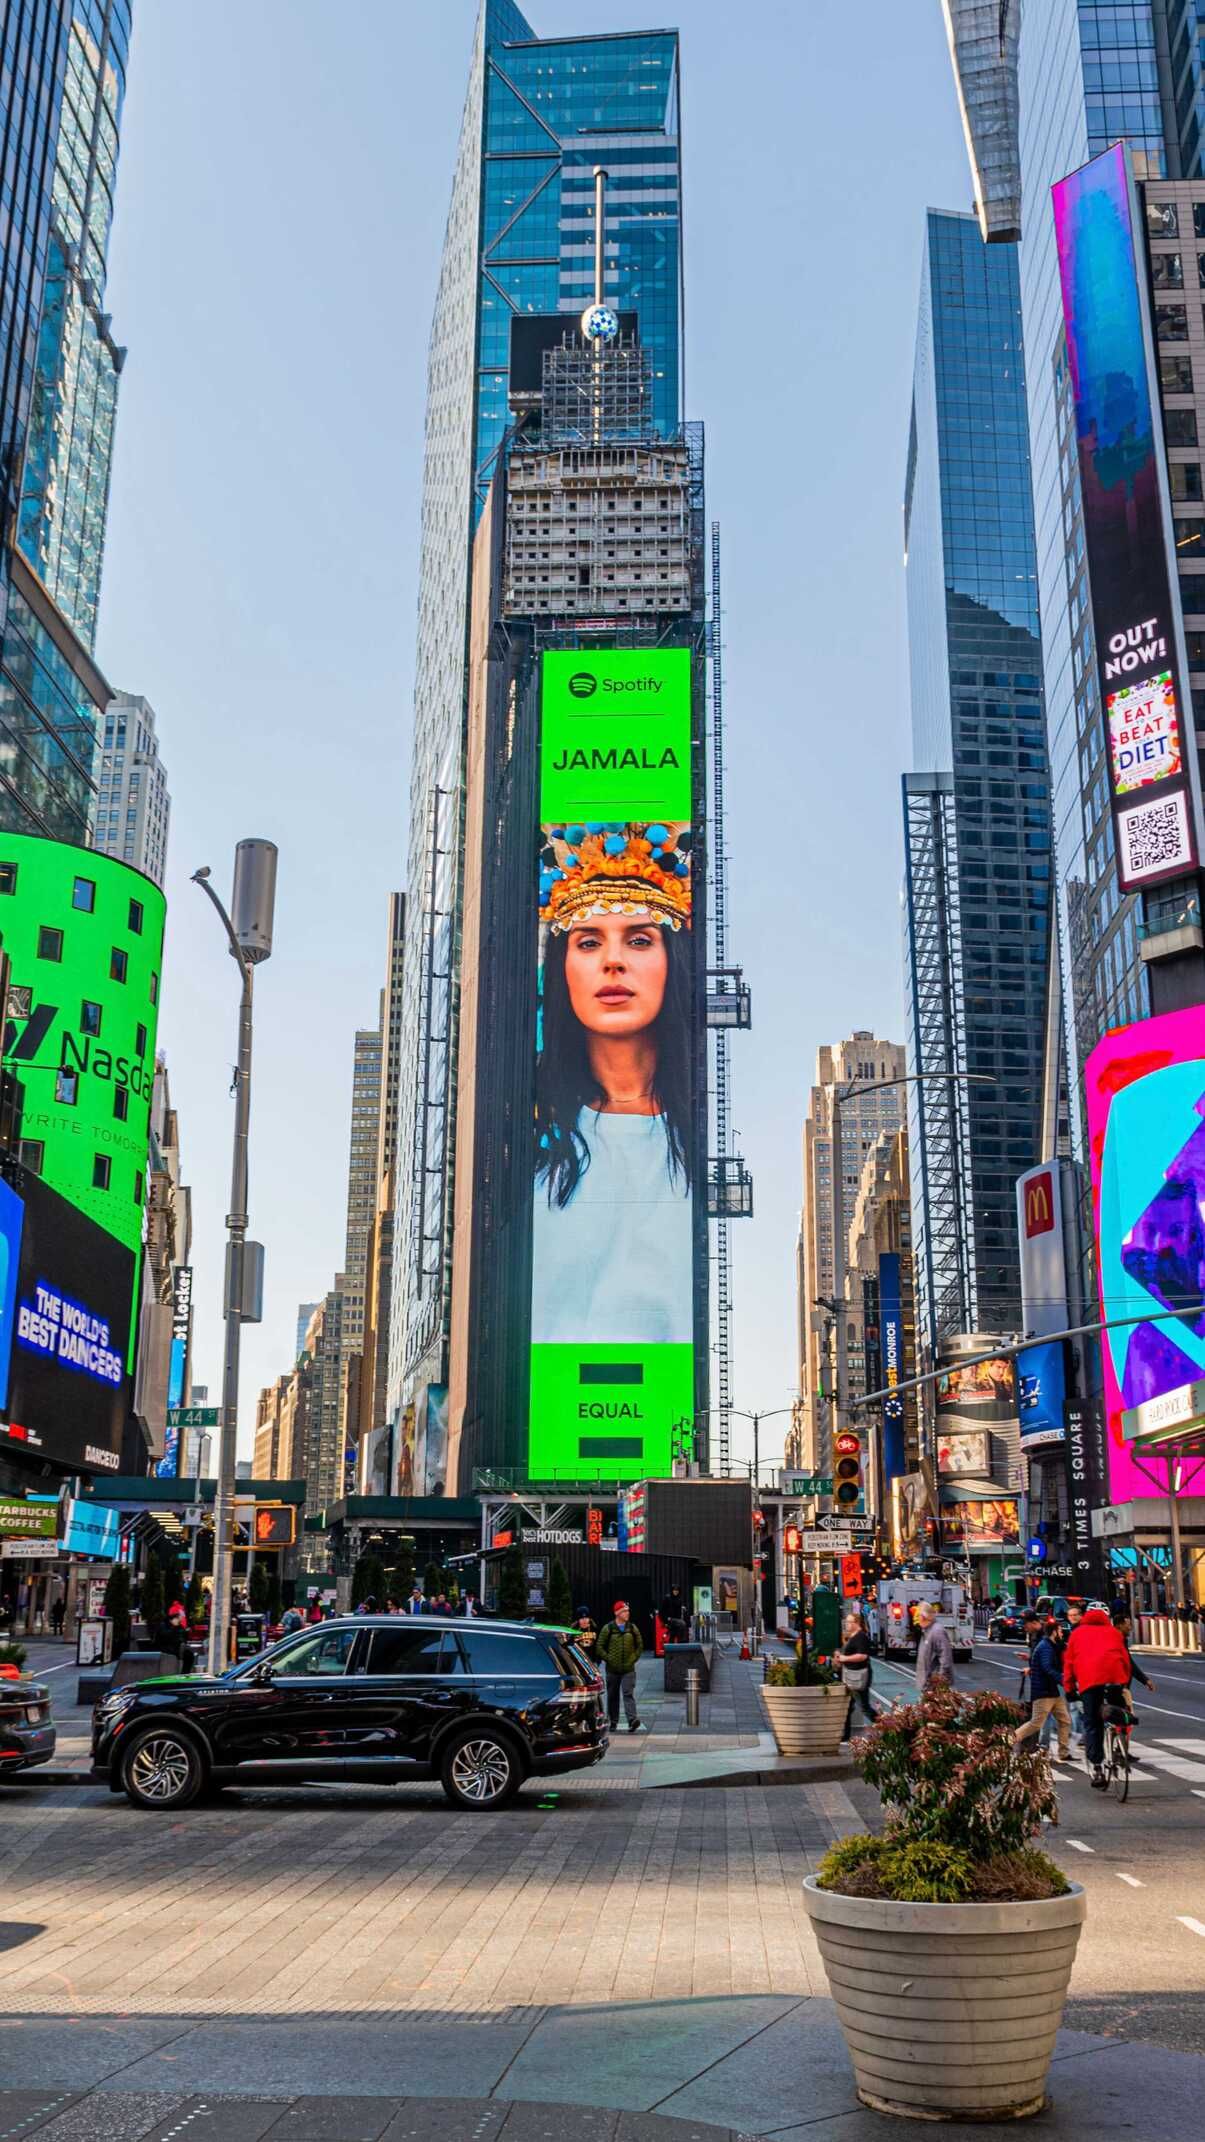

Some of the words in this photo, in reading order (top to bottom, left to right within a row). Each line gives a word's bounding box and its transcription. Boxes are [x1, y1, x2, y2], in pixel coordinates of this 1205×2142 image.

[1109, 618, 1157, 654] OUT
[1105, 638, 1167, 680] NOW!
[602, 677, 663, 693] Spotify
[1124, 700, 1155, 724] EAT
[1119, 716, 1164, 745] BEAT
[553, 747, 680, 770] JAMALA
[1119, 735, 1168, 770] DIET
[173, 1270, 192, 1321] Locker
[36, 1287, 61, 1322] THE
[61, 1302, 109, 1348] WORLD'S
[18, 1306, 59, 1352] BEST
[58, 1326, 122, 1383] DANCERS
[169, 1411, 180, 1425] W
[185, 1410, 202, 1425] 44
[578, 1403, 644, 1418] EQUAL
[1069, 1412, 1085, 1480] SQUARE
[794, 1480, 804, 1493] W
[808, 1480, 822, 1493] 44
[0, 1518, 42, 1529] COFFEE
[824, 1519, 841, 1528] ONE
[849, 1520, 868, 1528] WAY
[1074, 1497, 1088, 1550] TIMES
[537, 1529, 581, 1544] HOTDOGS
[1035, 1567, 1073, 1577] CHASE
[1078, 1560, 1089, 1569] 3
